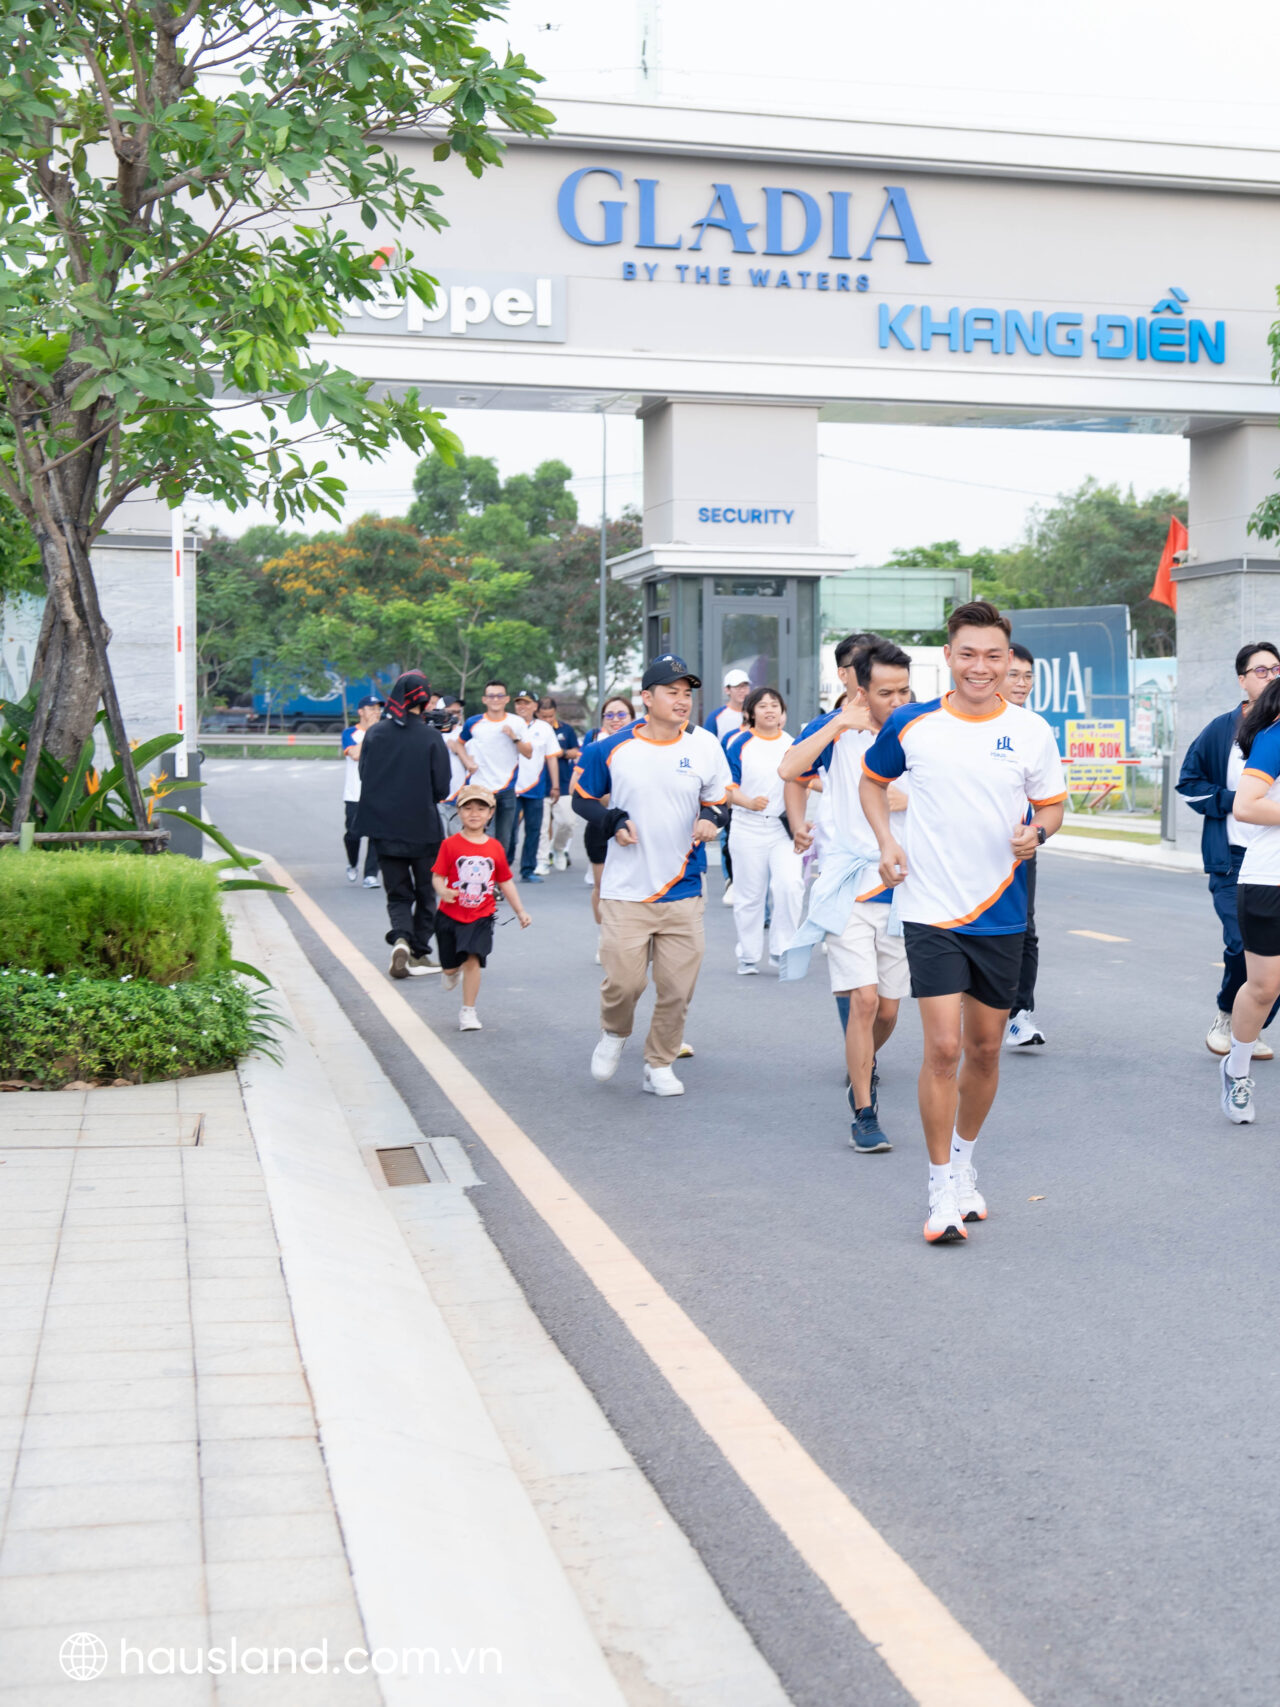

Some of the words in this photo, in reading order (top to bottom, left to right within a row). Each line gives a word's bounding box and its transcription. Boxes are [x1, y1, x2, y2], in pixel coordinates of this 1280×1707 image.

[557, 166, 932, 265] GLADIA
[622, 261, 659, 281] BY
[676, 264, 731, 286] THE
[749, 268, 870, 293] WATERS
[324, 278, 552, 334] eppel
[878, 302, 1084, 358] KHANG
[1091, 287, 1226, 364] ĐIỀN
[697, 507, 795, 524] SECURITY
